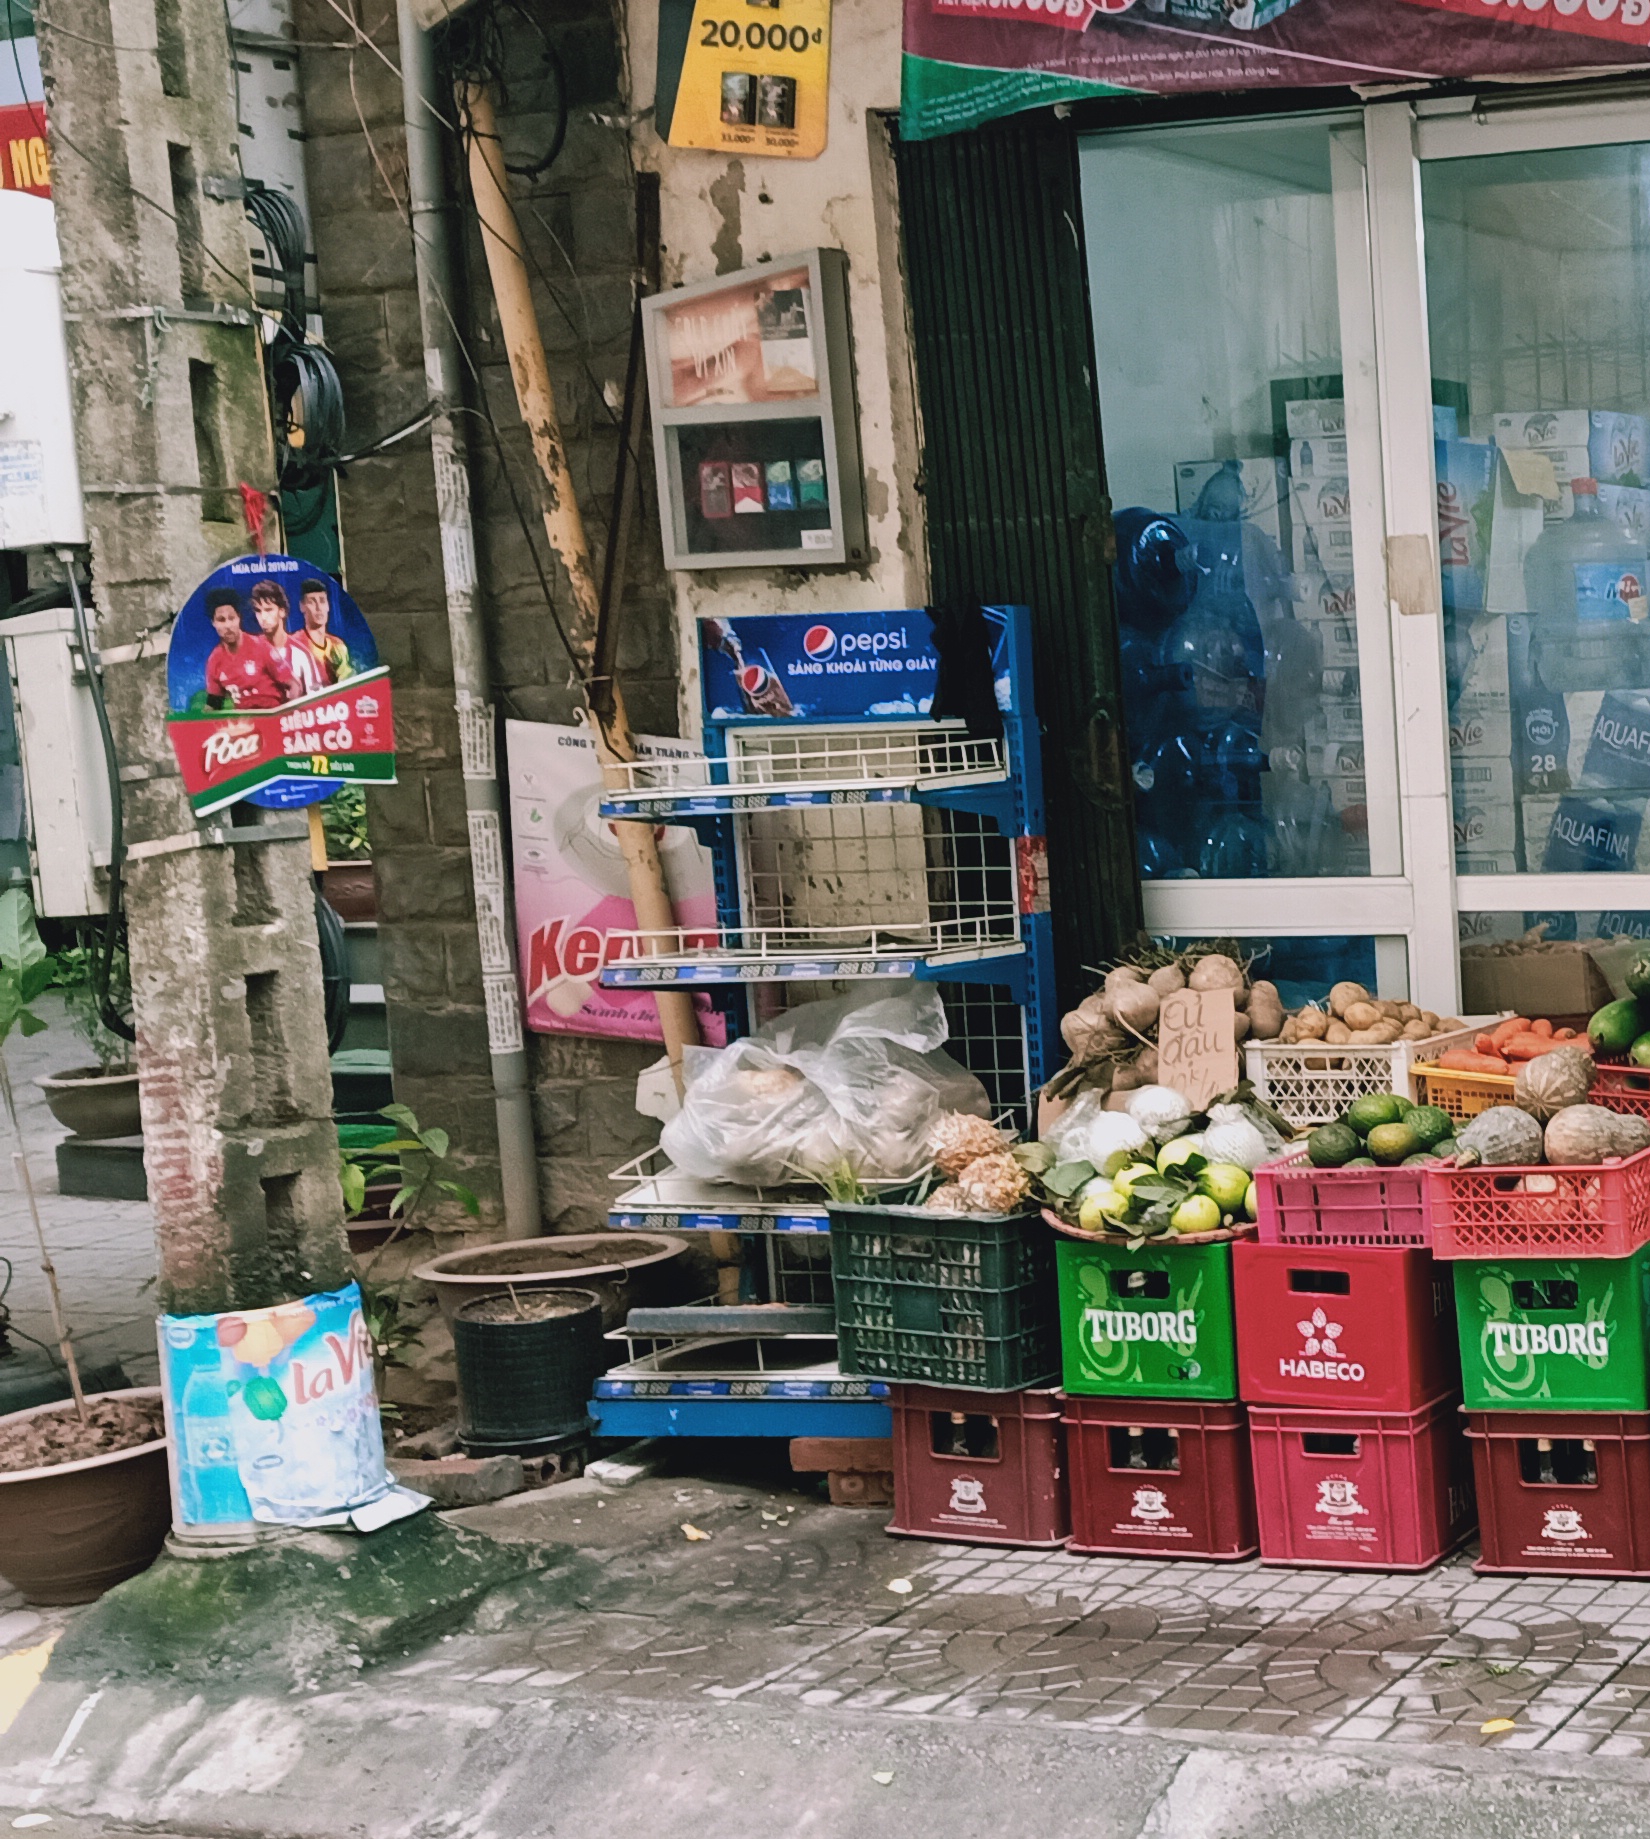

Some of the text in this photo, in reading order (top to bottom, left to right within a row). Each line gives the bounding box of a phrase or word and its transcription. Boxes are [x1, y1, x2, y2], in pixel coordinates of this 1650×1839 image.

[0, 136, 51, 188] NG
[840, 626, 908, 656] pepsi
[315, 700, 350, 725] SAO
[201, 731, 260, 773] Poca
[323, 721, 353, 751] CỎ
[1531, 754, 1557, 773] 28
[1552, 812, 1630, 863] AQUAFINA
[1085, 1307, 1198, 1344] TUBORG
[1486, 1320, 1609, 1357] TUBORG
[1279, 1358, 1365, 1382] HABECO
